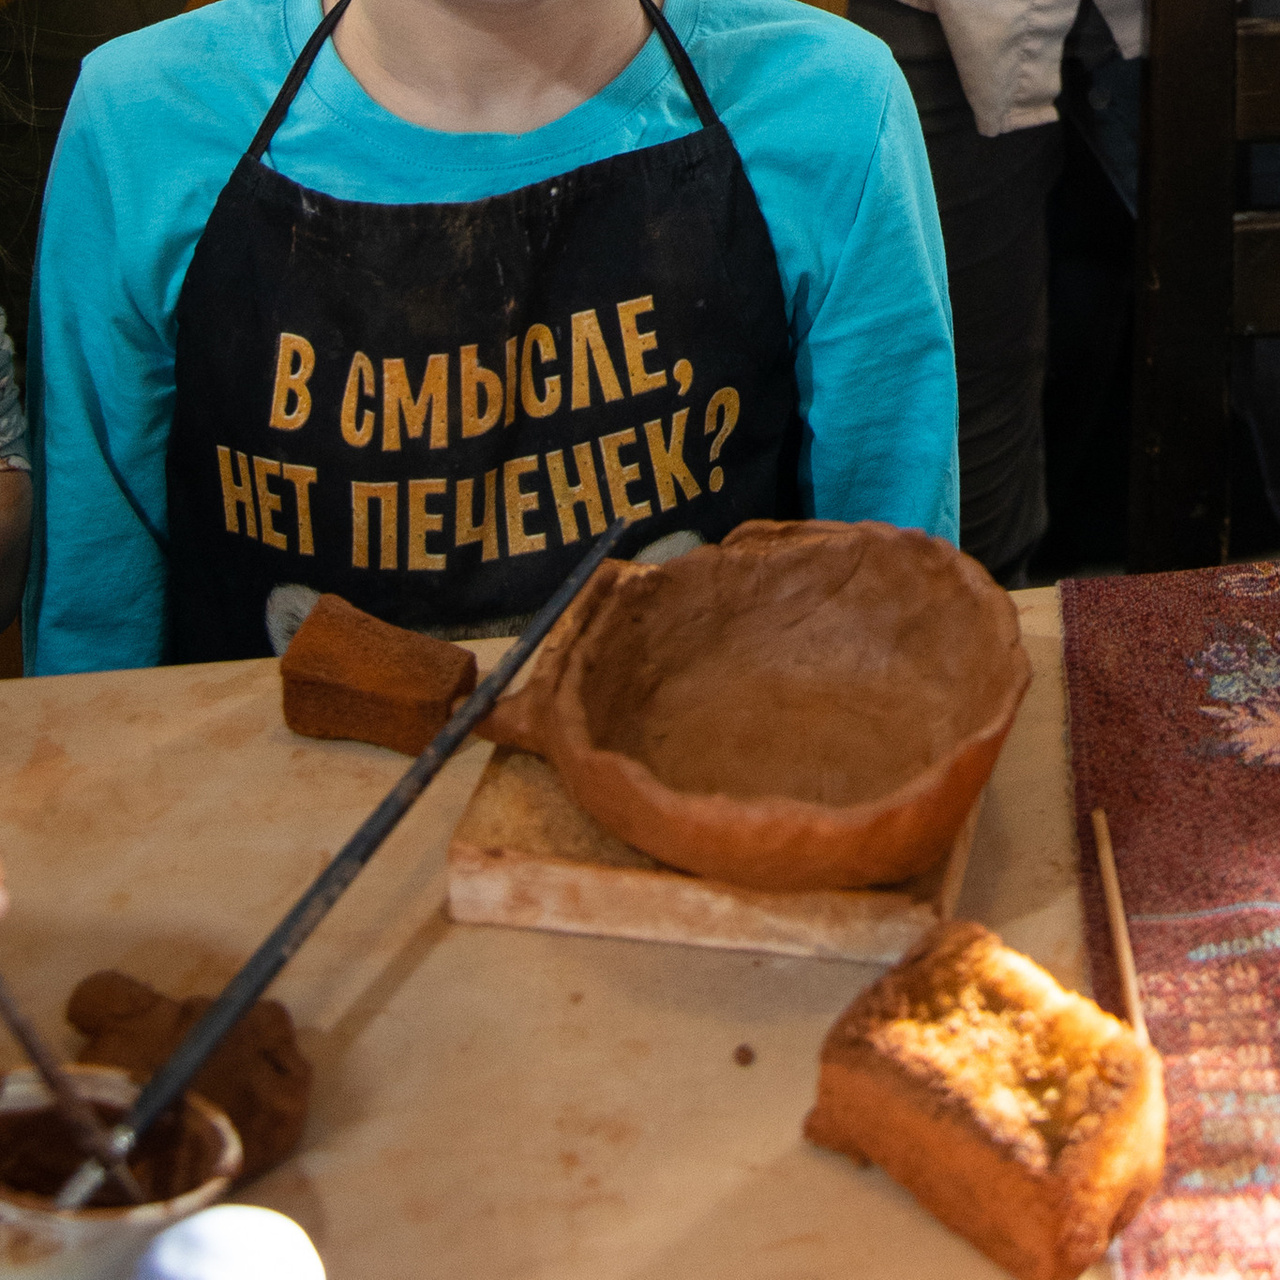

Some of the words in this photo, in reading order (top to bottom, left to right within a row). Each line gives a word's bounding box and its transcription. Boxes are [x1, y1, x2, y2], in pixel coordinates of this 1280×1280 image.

[269, 332, 316, 432] В
[340, 294, 694, 453] СМЫСЛЕ,
[216, 444, 318, 557] НЕТ
[351, 385, 741, 572] ПЕЧЕНЕК?
